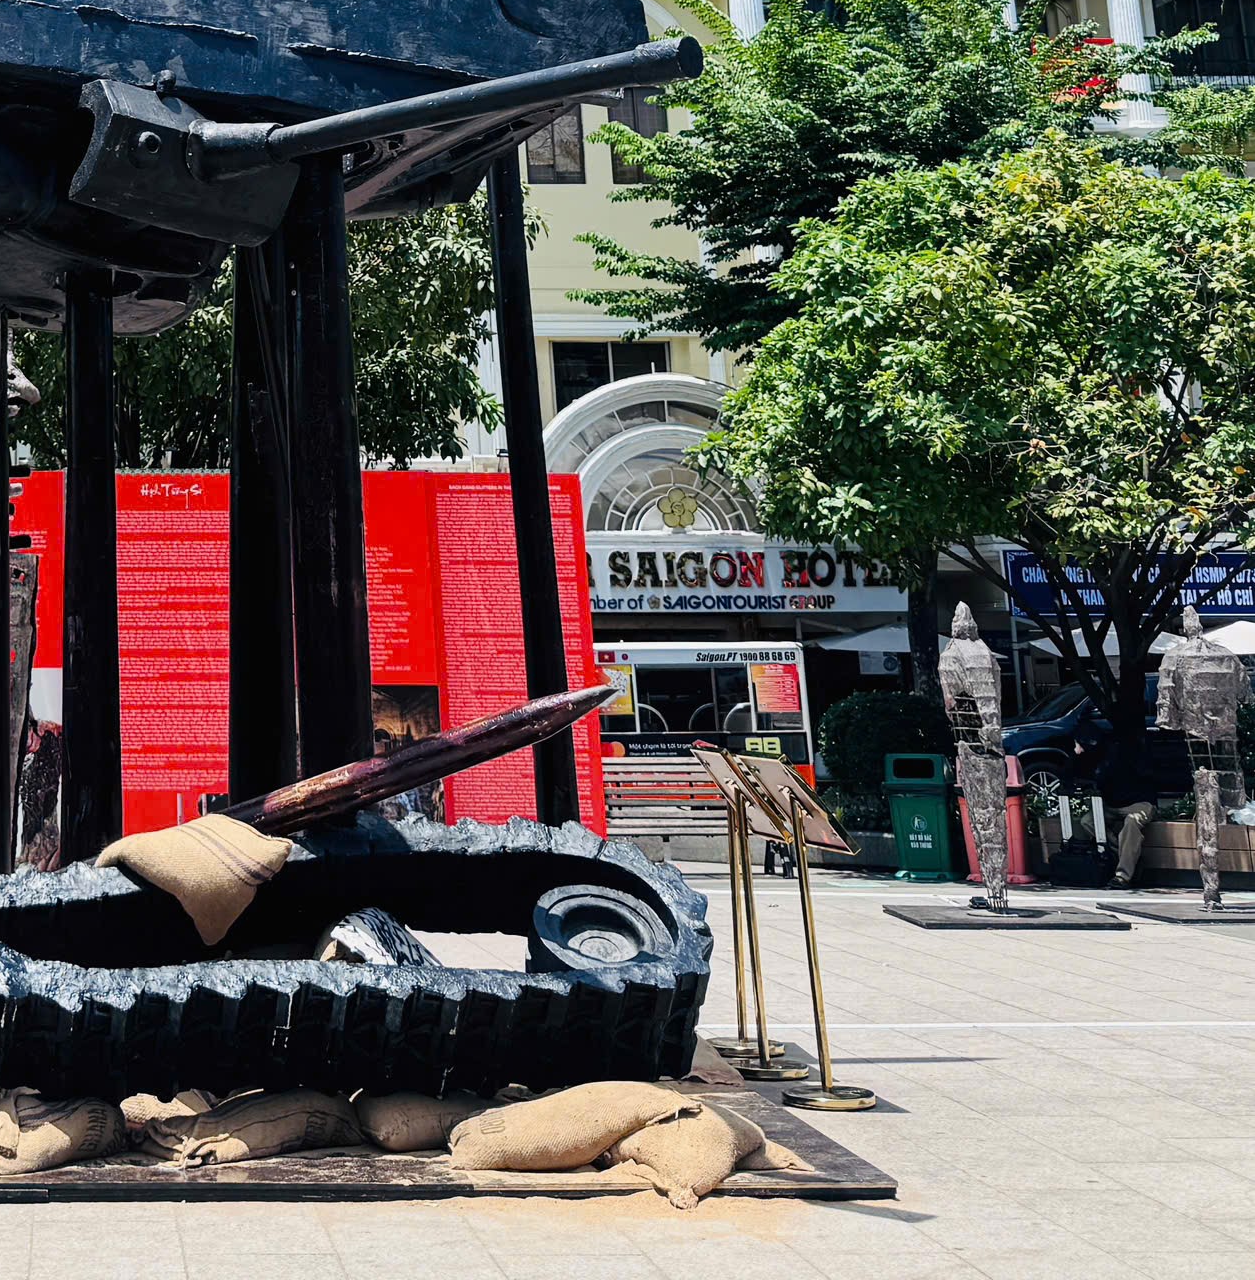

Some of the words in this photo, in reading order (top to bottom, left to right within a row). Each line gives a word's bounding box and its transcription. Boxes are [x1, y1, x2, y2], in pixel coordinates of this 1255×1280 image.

[608, 550, 765, 588] SAIGON
[627, 594, 644, 610] of
[662, 594, 787, 610] SAIGONTOURIST
[789, 595, 835, 610] GROUP
[739, 651, 758, 661] 1900
